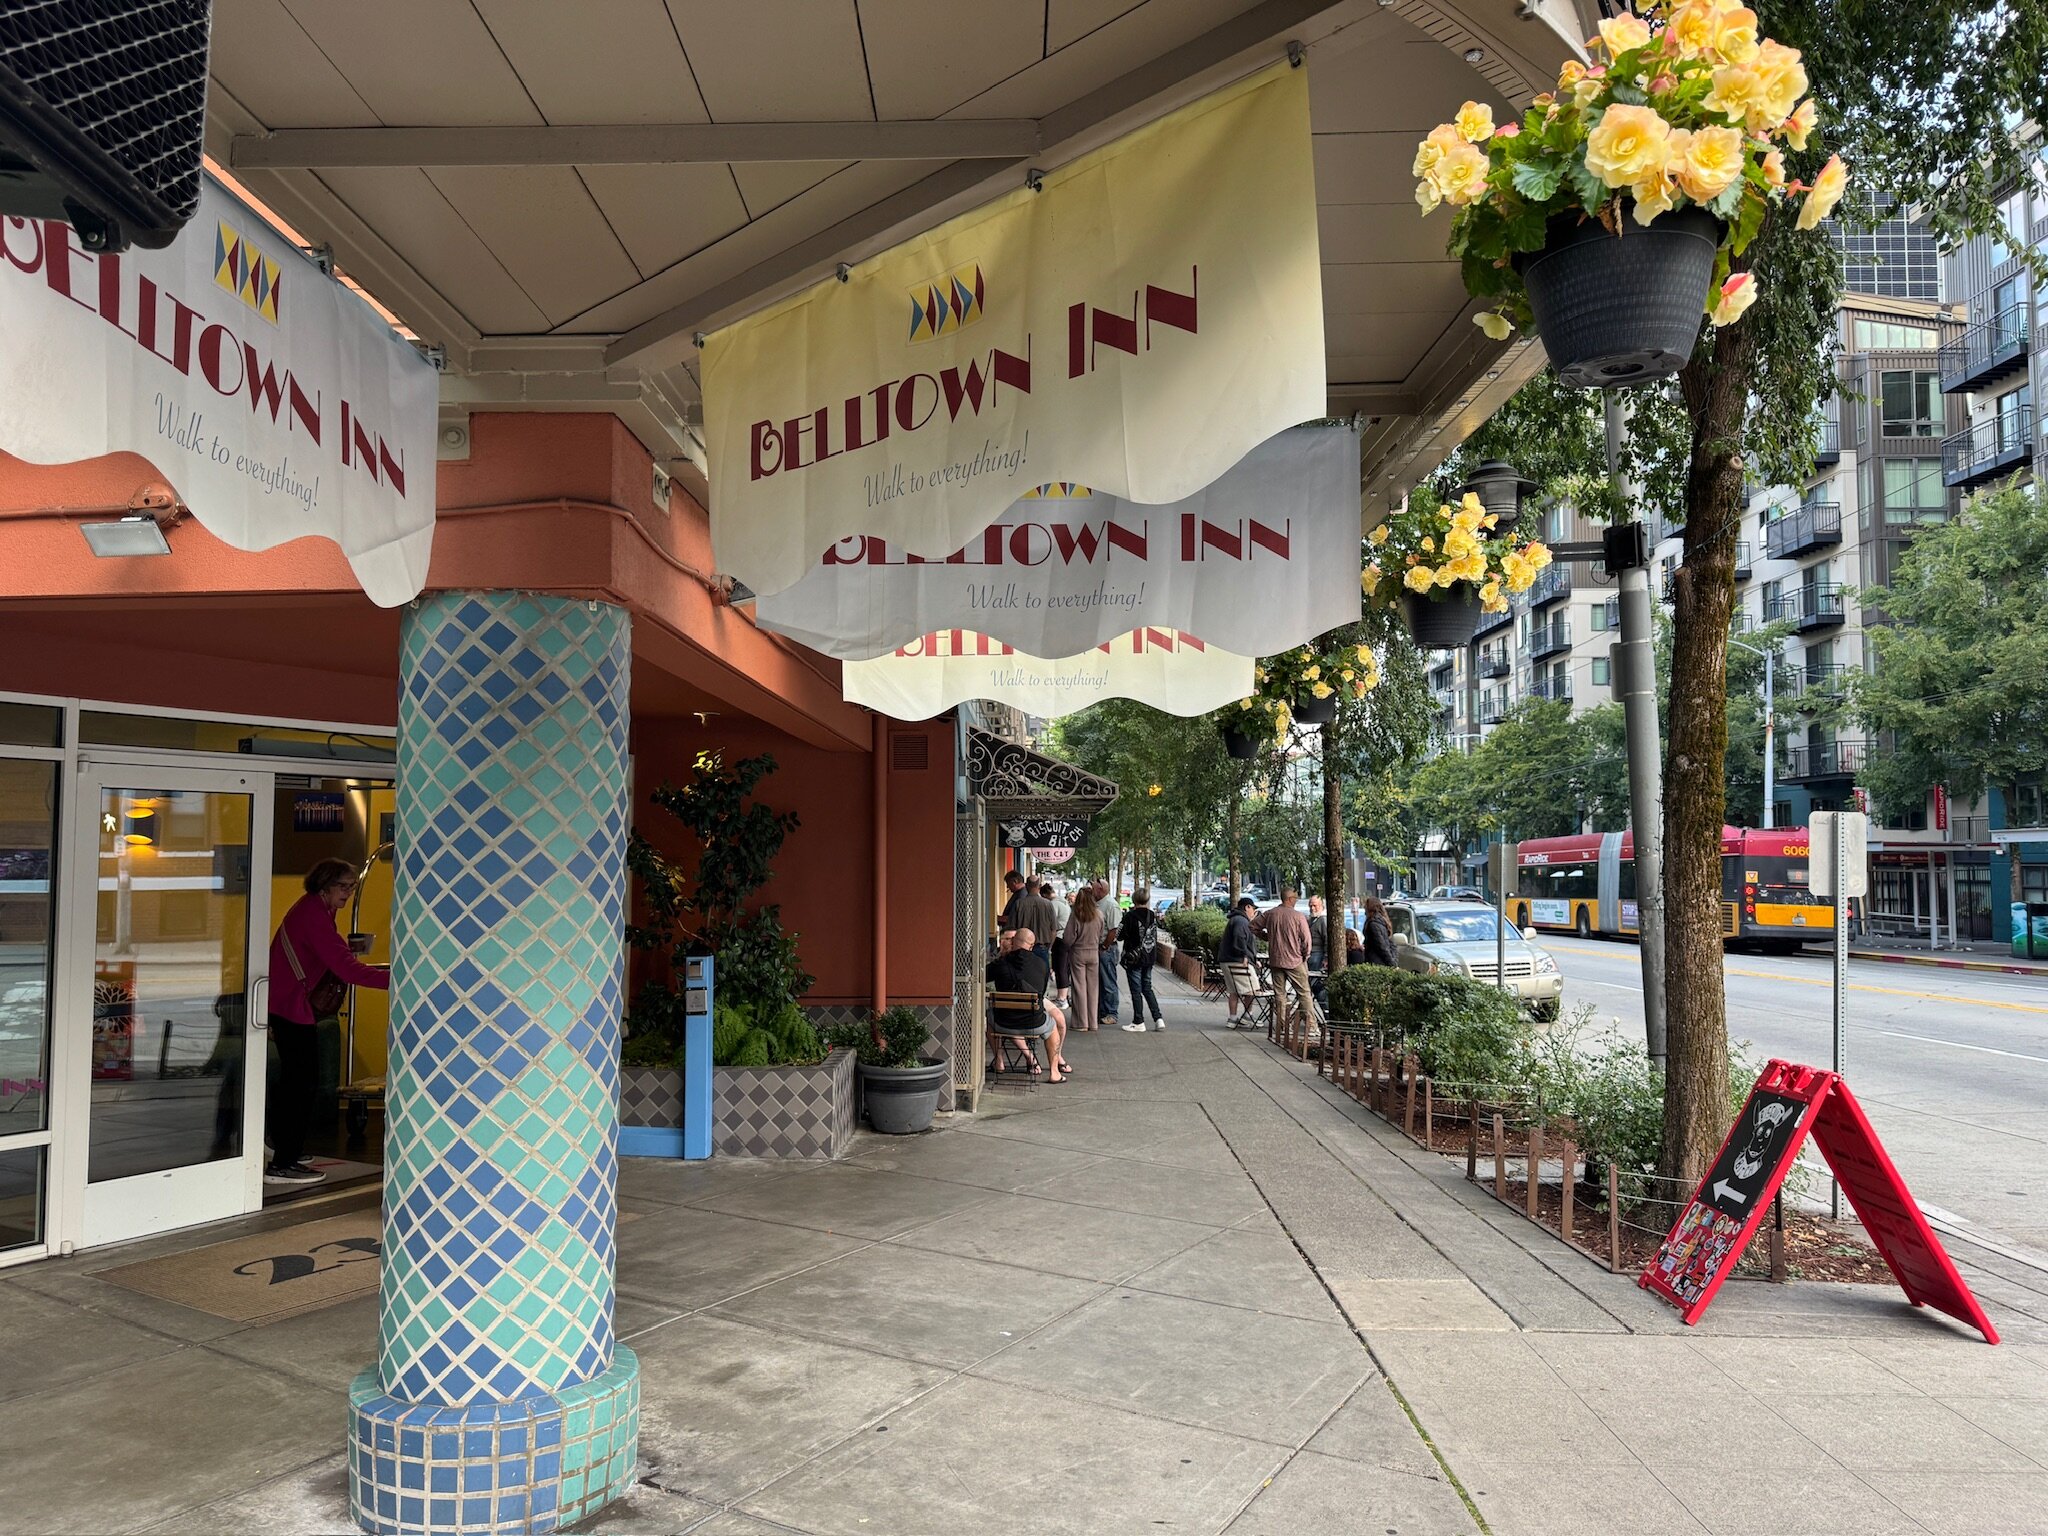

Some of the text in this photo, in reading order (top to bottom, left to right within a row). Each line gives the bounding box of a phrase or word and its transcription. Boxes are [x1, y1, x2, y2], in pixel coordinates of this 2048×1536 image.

[751, 264, 1198, 481] BELLTOWN INN
[155, 392, 319, 511] Walk to everything!
[341, 400, 406, 499] INN
[863, 429, 1029, 507] Walk to everything!
[823, 513, 1290, 566] BTOWN INN
[967, 580, 1145, 613] Walk to everything!
[1133, 626, 1205, 654] INN
[990, 668, 1109, 689] Walk to everything!
